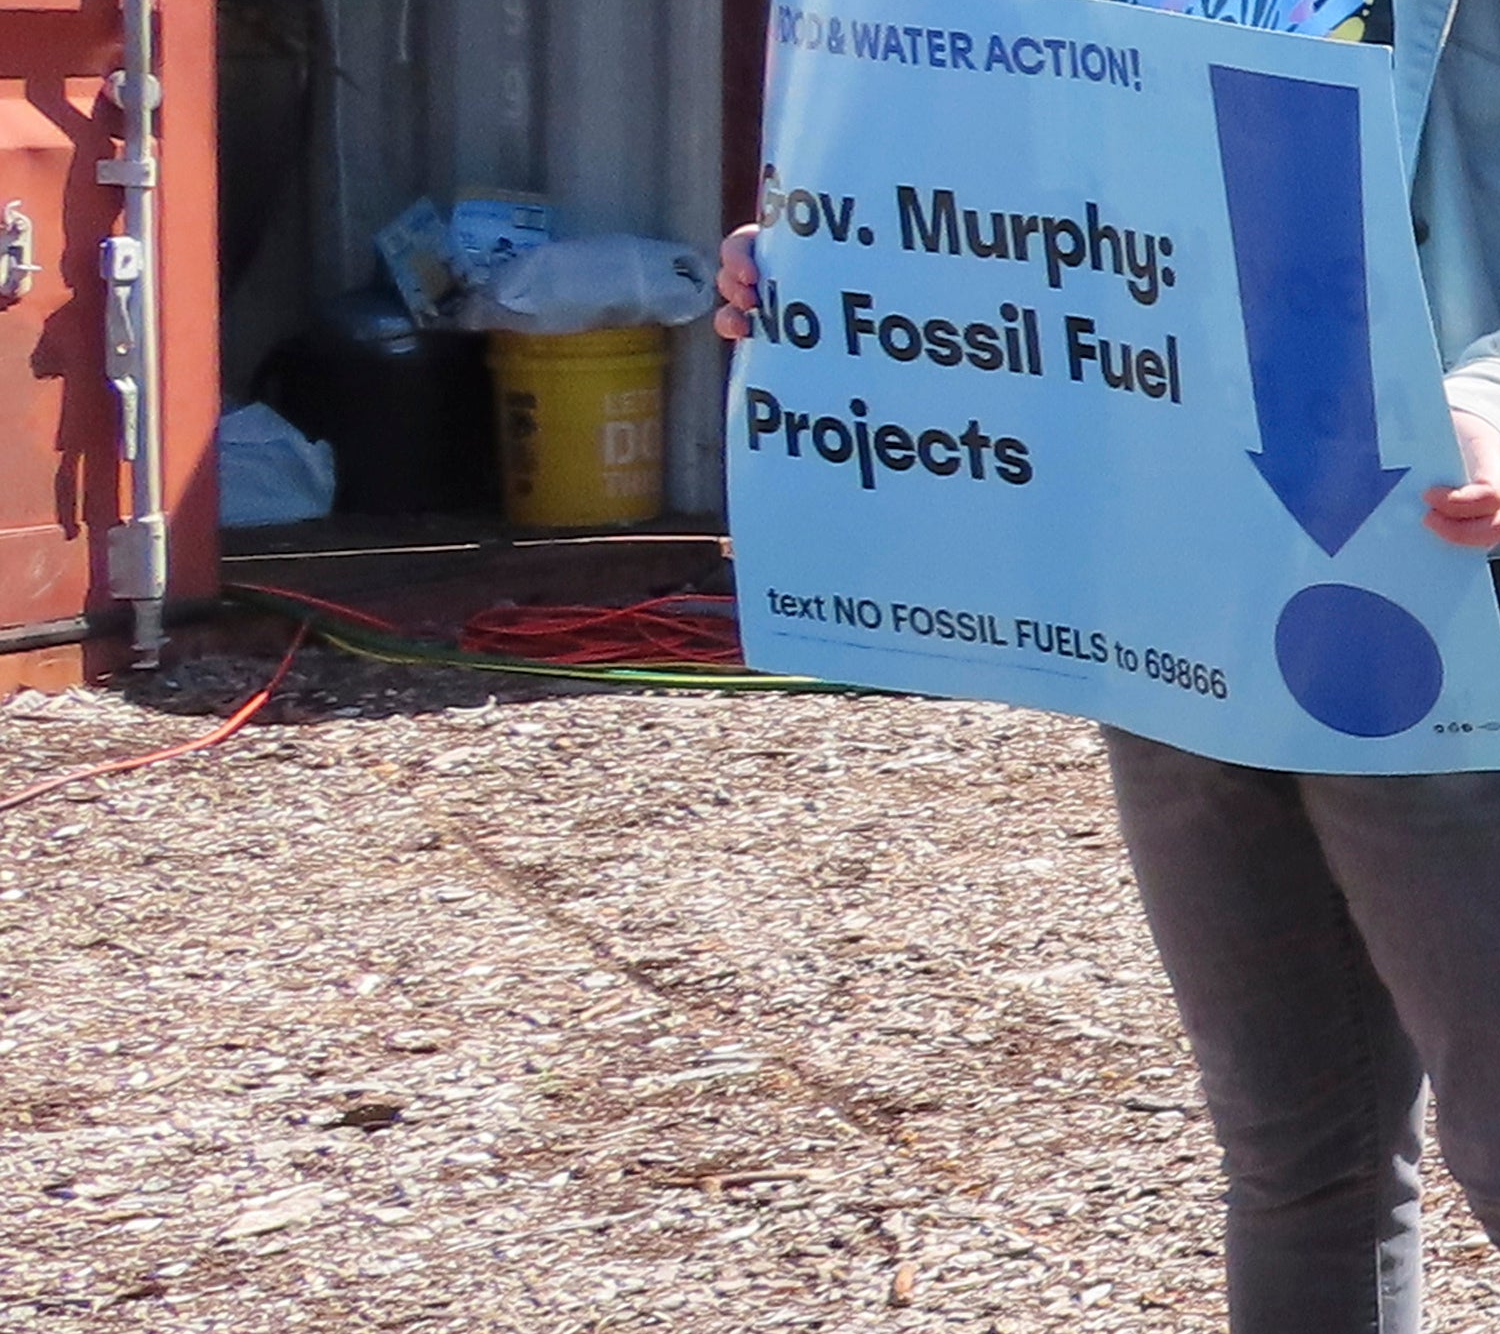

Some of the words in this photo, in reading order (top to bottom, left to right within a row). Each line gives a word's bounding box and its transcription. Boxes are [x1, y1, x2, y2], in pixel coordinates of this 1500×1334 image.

[827, 15, 847, 55] &
[851, 19, 978, 71] WATER
[985, 33, 1142, 92] ACTION!
[895, 184, 1176, 306] Murphy:
[749, 279, 821, 350] No
[840, 289, 1044, 376] Fossil
[1064, 314, 1182, 405] Fuel
[745, 386, 1034, 490] Projects
[767, 586, 827, 623] text
[833, 594, 883, 630] NO
[891, 603, 1009, 647] FOSSIL
[1015, 618, 1109, 664] FUELS
[1114, 640, 1139, 673] to
[1144, 647, 1229, 701] 69866
